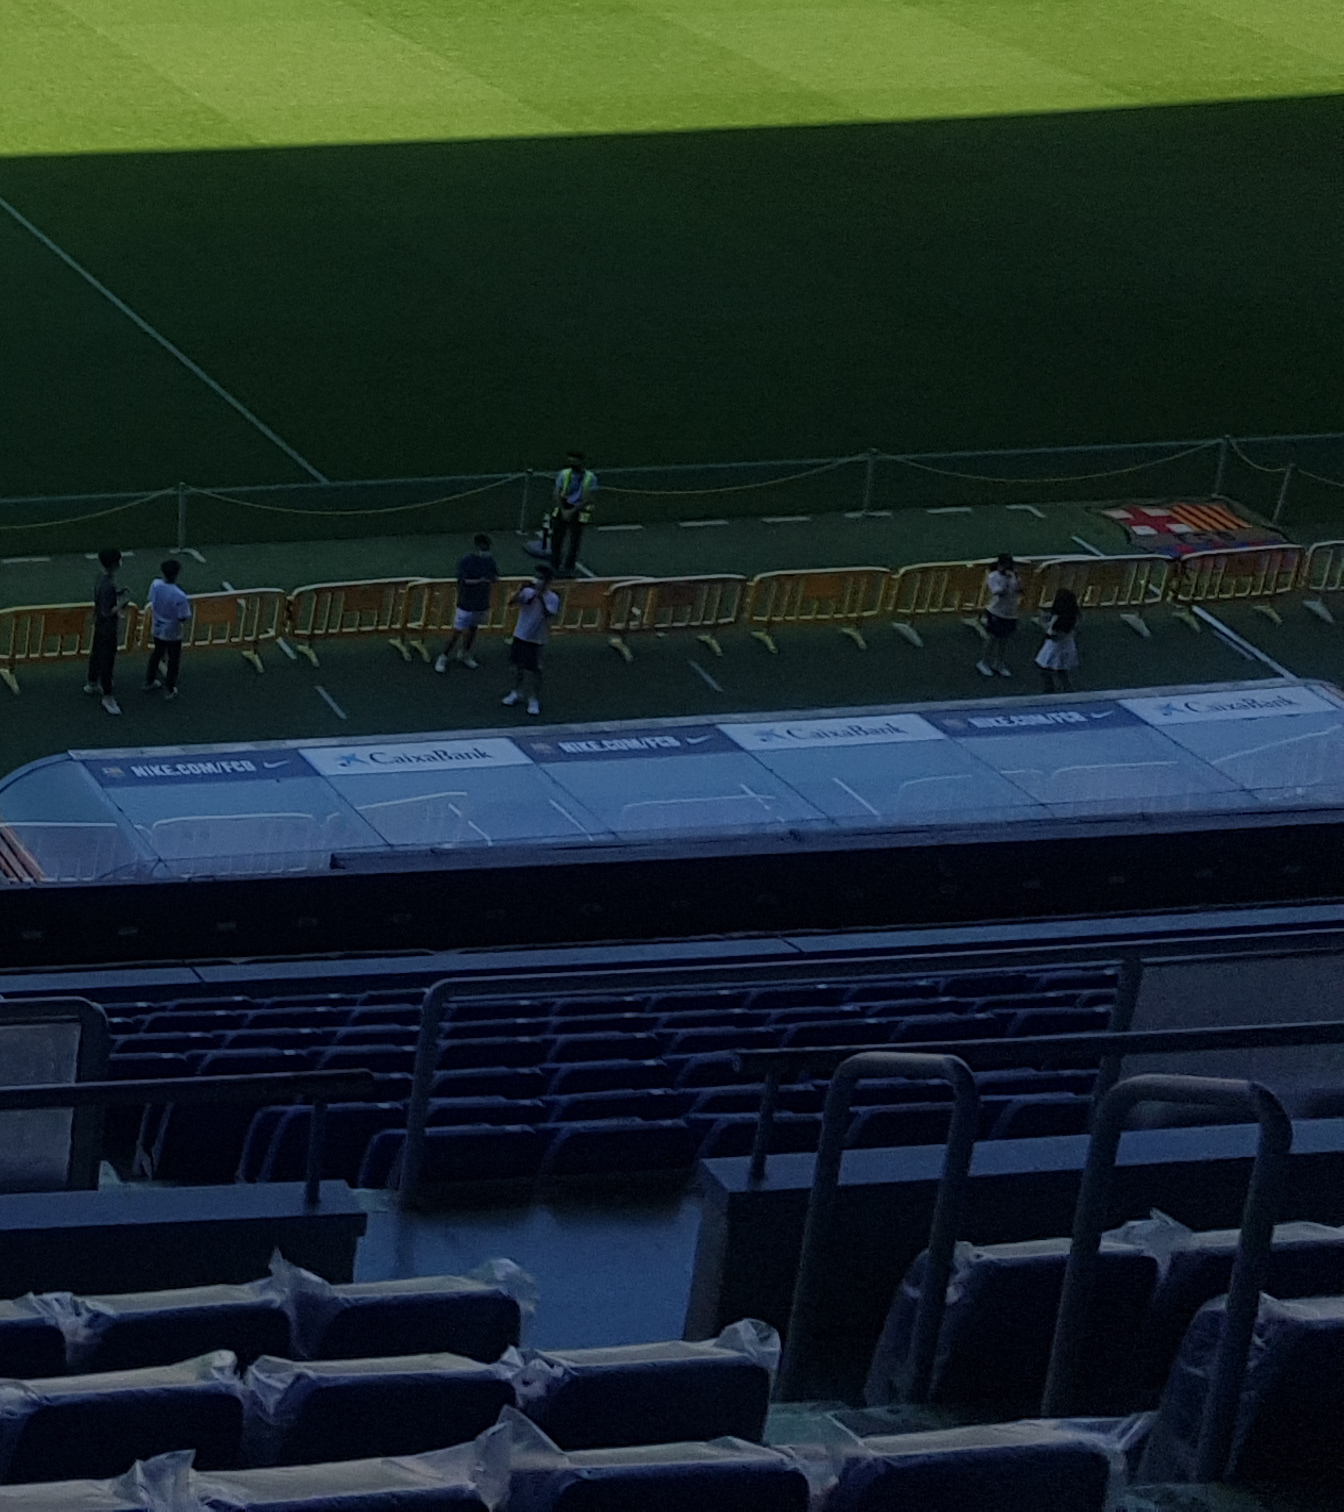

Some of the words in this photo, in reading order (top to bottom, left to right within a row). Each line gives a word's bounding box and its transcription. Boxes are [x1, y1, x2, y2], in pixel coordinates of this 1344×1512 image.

[1184, 695, 1300, 714] CaixaBank
[785, 719, 906, 742] CaixaBank
[557, 735, 681, 753] NIKE.COM/FCB
[369, 744, 493, 765] CaixaBank
[130, 759, 258, 779] NIKE.COM/FCB
